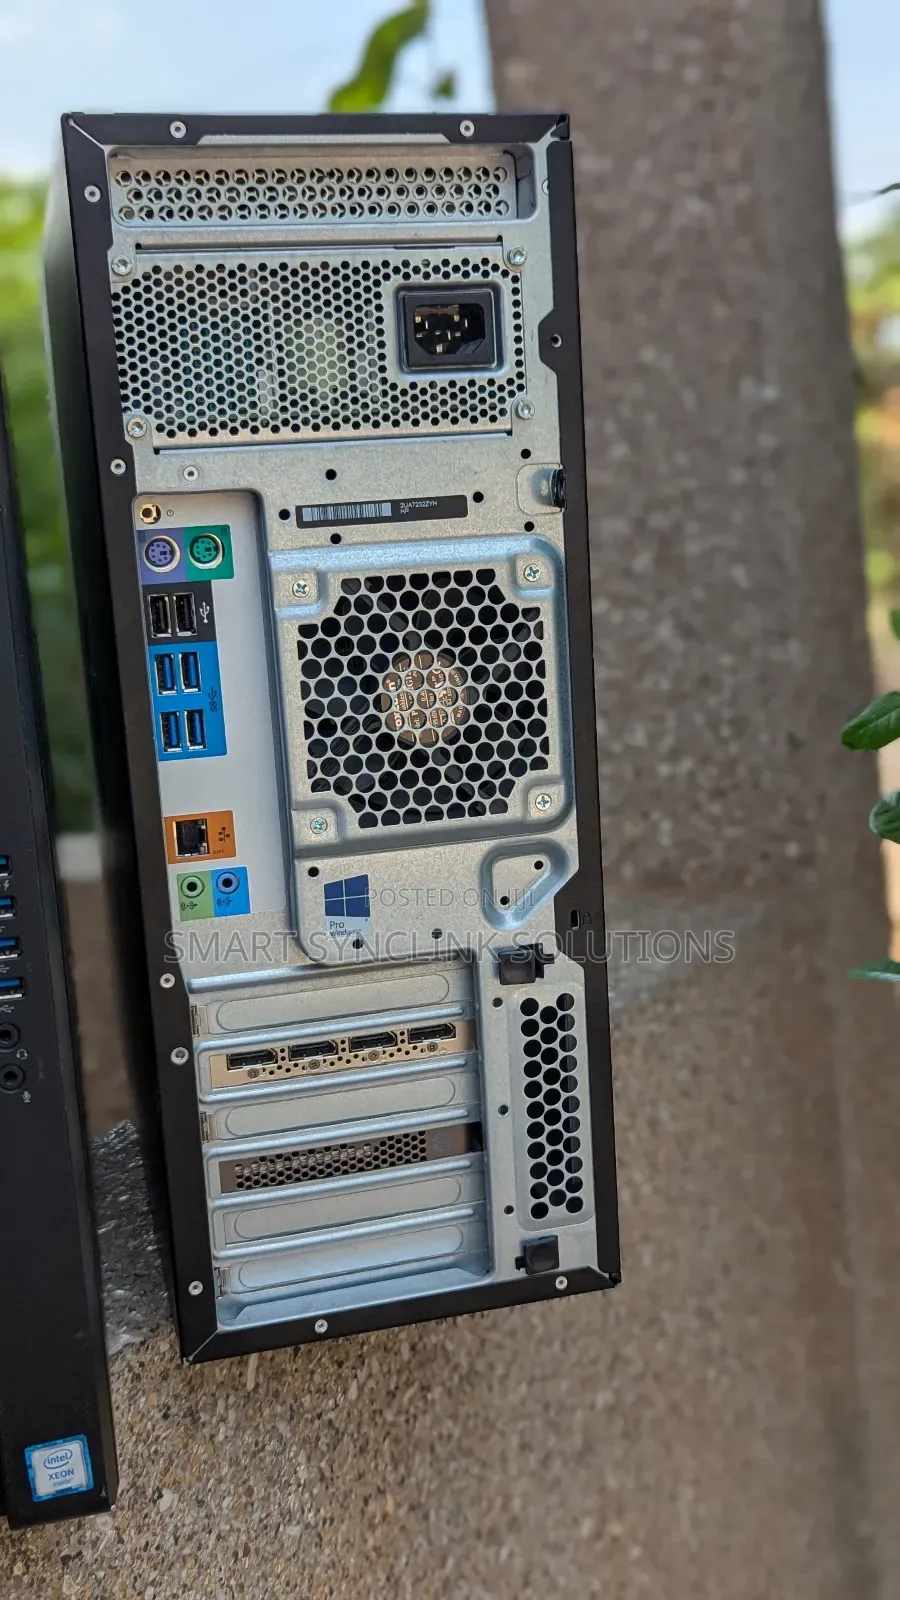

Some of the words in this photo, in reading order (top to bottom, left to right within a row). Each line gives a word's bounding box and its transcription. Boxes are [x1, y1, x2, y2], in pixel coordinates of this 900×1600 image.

[329, 920, 345, 930] Pro
[47, 1452, 70, 1465] intel
[48, 1468, 75, 1481] XEON
